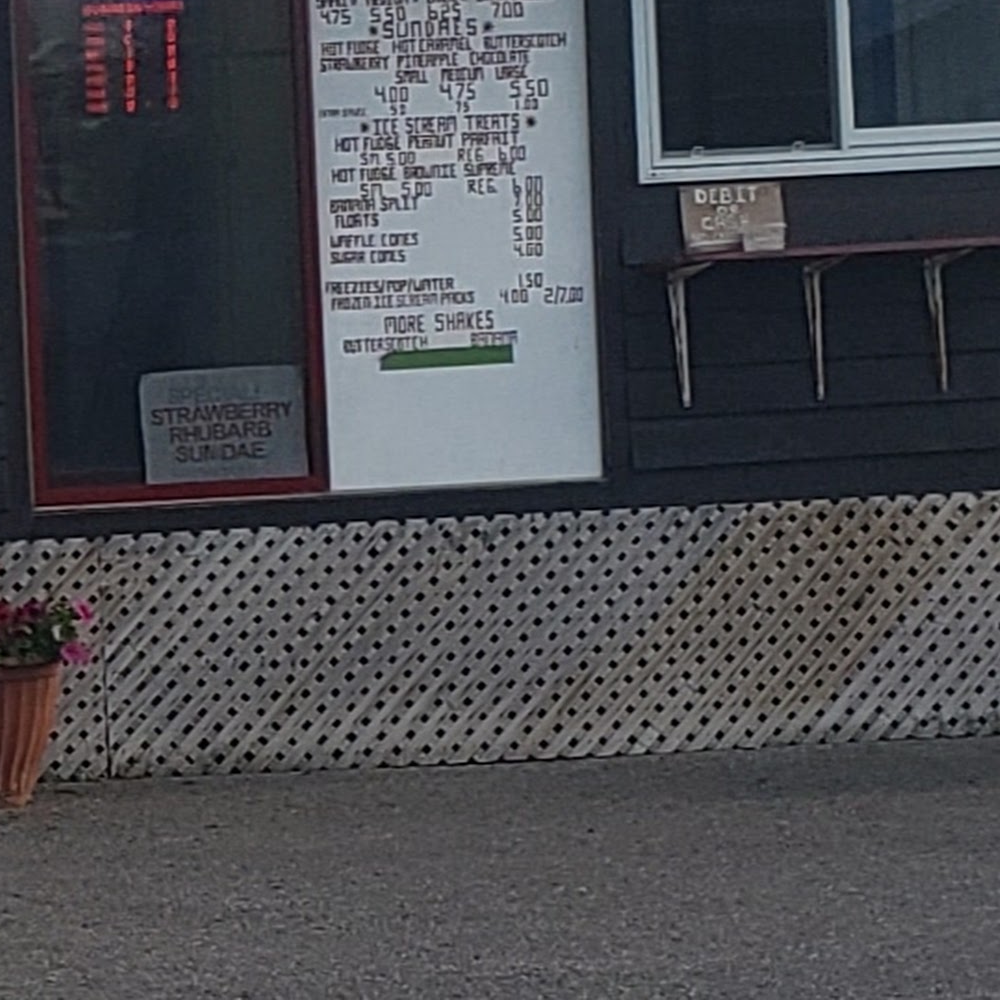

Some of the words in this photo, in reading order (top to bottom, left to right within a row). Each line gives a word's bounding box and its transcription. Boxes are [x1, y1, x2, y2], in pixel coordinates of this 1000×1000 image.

[381, 18, 478, 40] SUNDAES
[372, 117, 399, 136] ICE
[463, 113, 520, 131] TREATS
[334, 136, 360, 153] HOT
[330, 167, 356, 183] HOT
[693, 185, 758, 204] DEBIT
[334, 212, 380, 229] FLOATS
[383, 313, 426, 335] MORE
[434, 309, 495, 333] SHAKES
[150, 401, 293, 427] STRAWBERRY
[168, 419, 273, 445] RHUBARB
